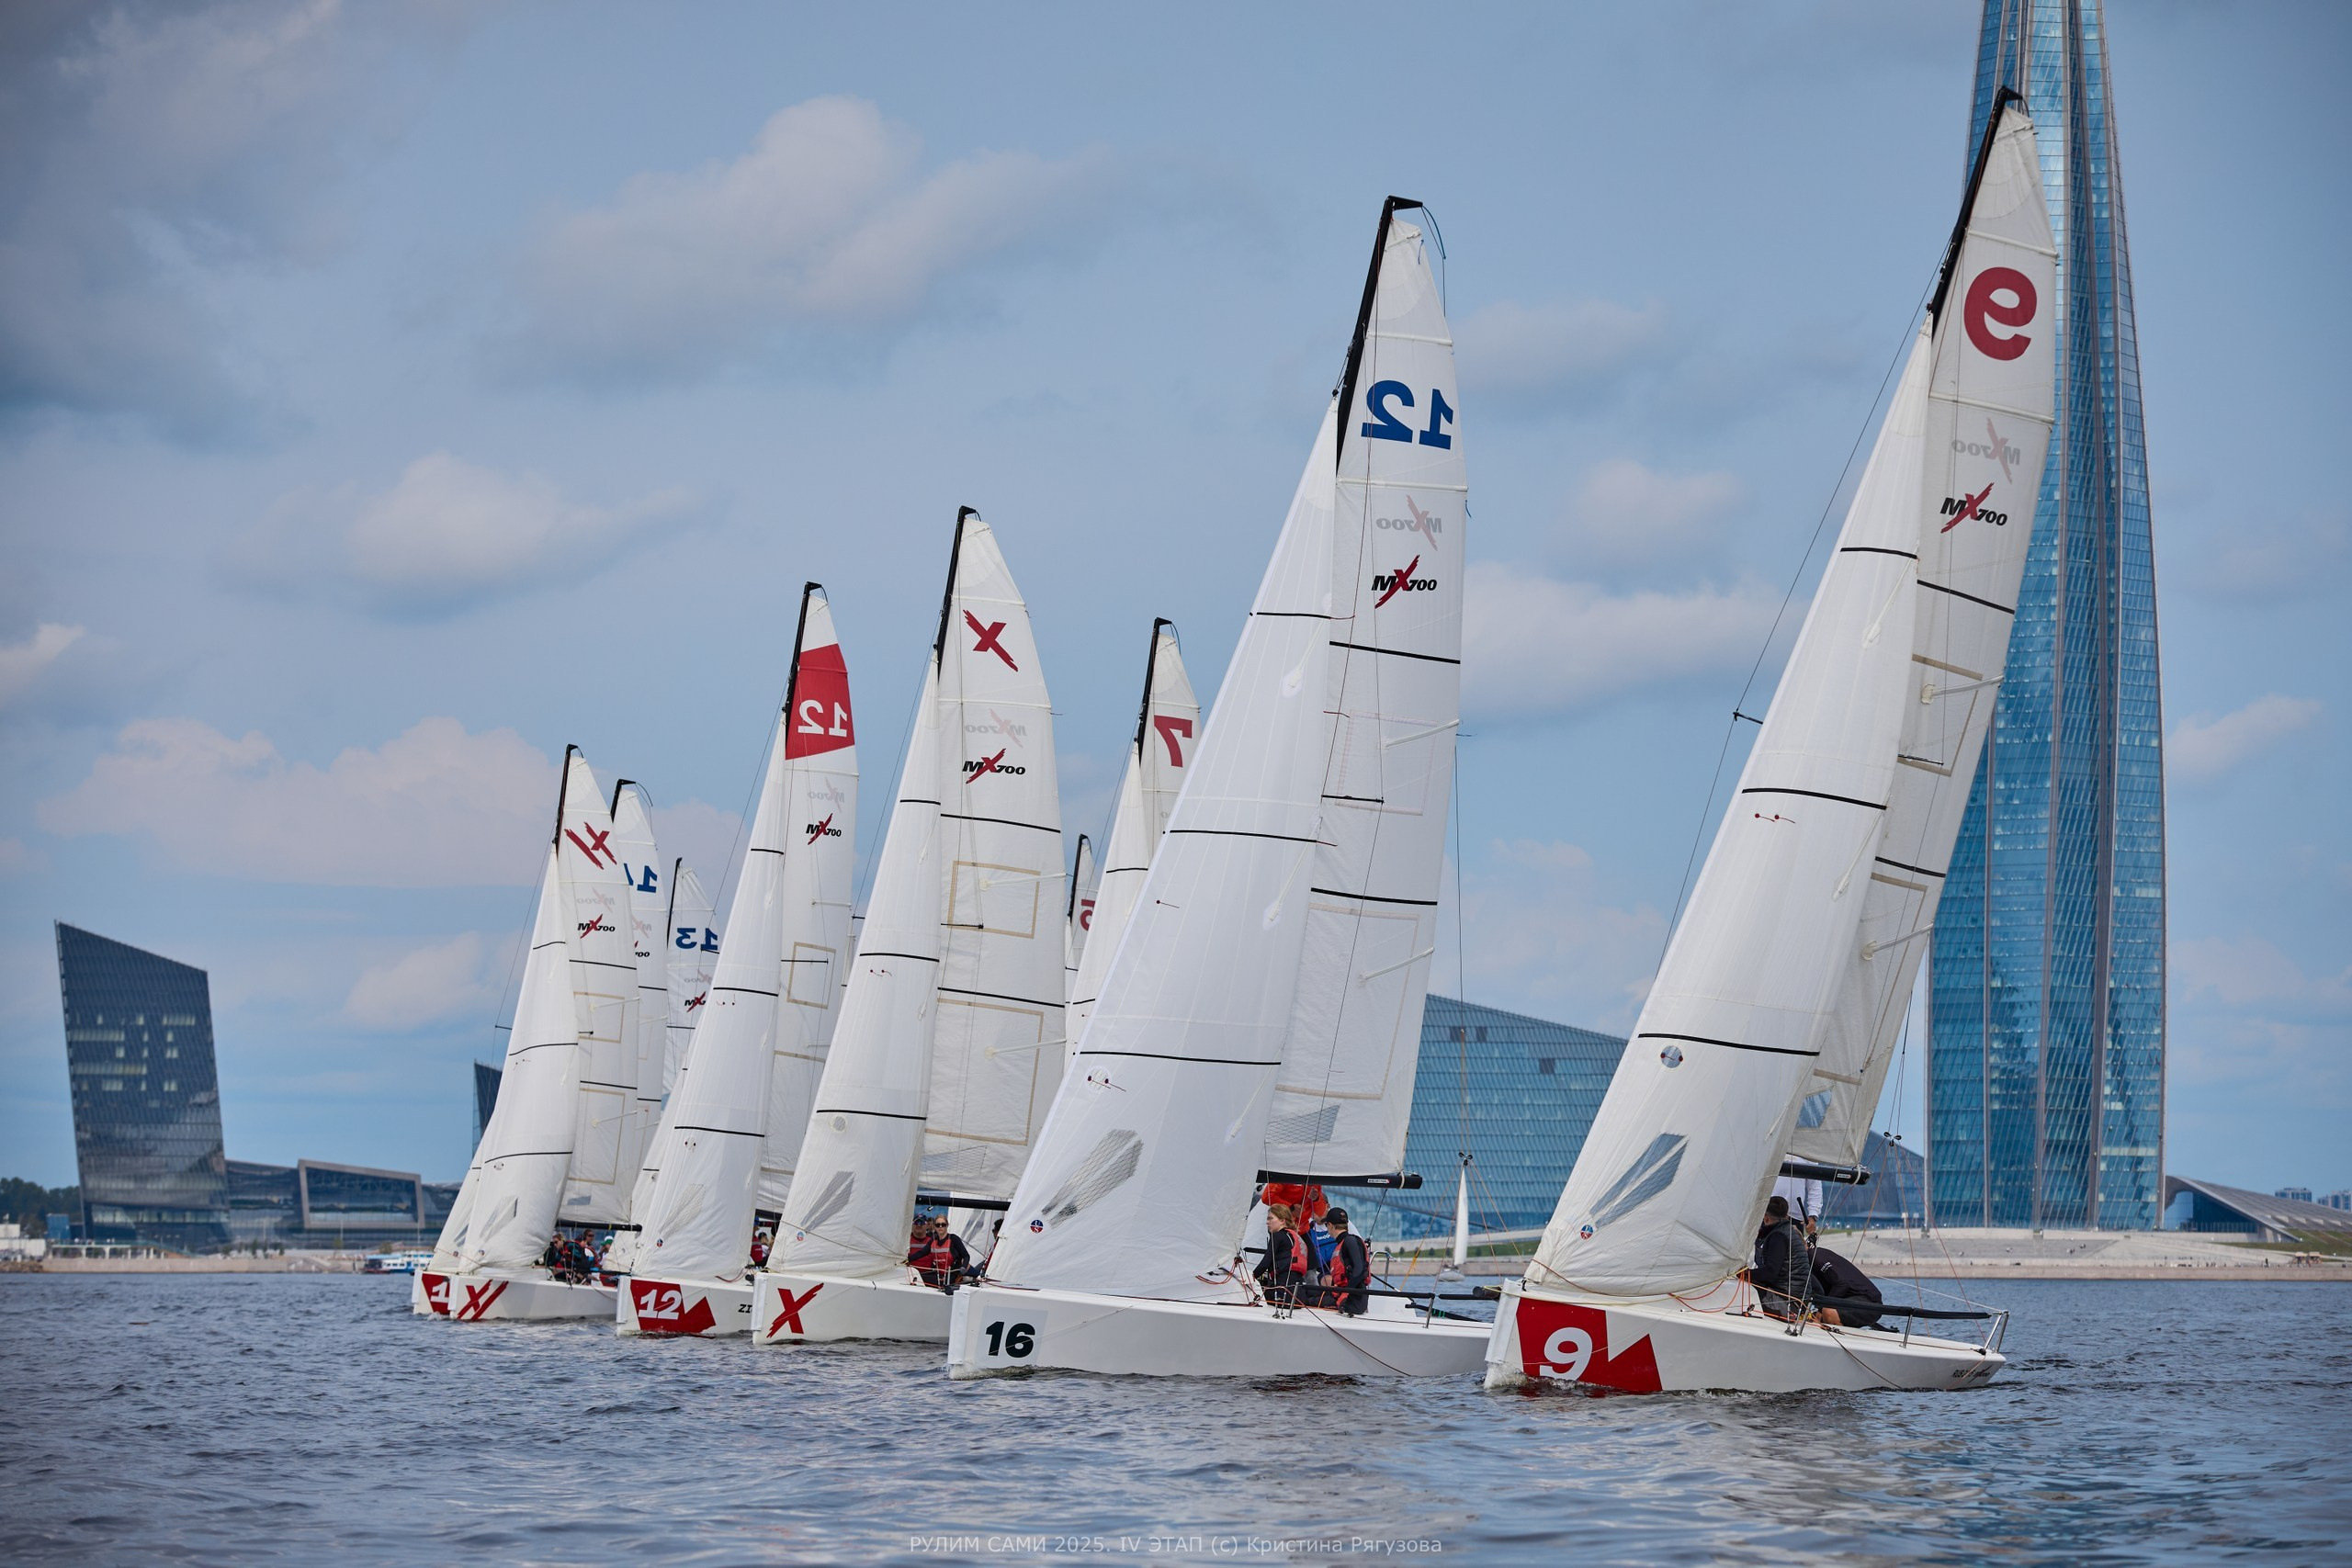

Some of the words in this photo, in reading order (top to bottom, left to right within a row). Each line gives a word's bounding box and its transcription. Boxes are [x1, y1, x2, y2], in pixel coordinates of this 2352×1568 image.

[1939, 482, 2008, 534] MX700
[1372, 554, 1437, 609] MX700
[962, 748, 1025, 784] MX700
[805, 813, 842, 845] MX700
[577, 913, 616, 939] MX700
[684, 991, 707, 1012] MX7
[638, 1289, 682, 1320] 12
[738, 1303, 753, 1314] ZI
[766, 1282, 825, 1338] X
[985, 1321, 1035, 1358] 16
[1539, 1326, 1593, 1382] 9
